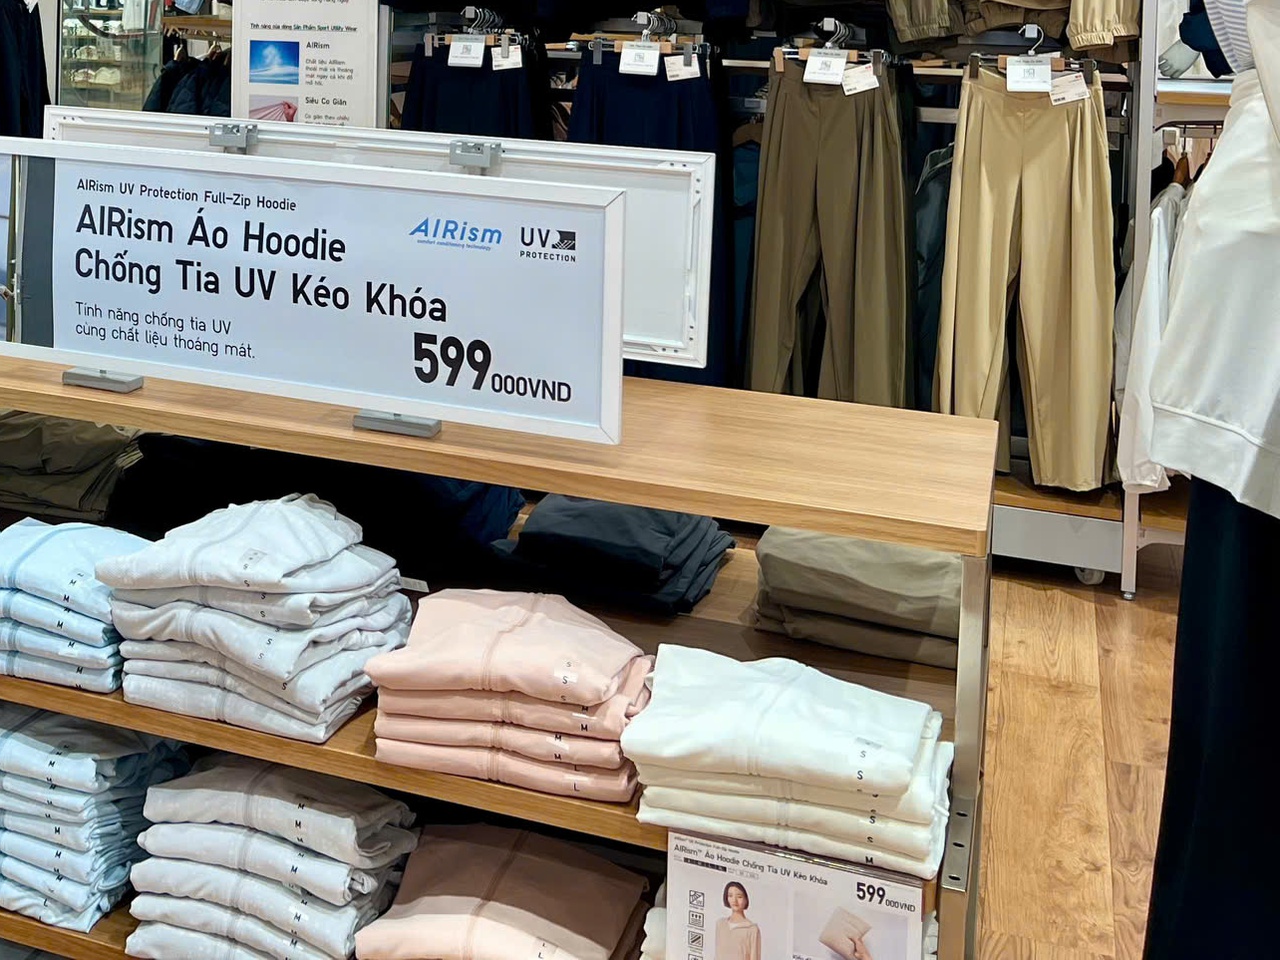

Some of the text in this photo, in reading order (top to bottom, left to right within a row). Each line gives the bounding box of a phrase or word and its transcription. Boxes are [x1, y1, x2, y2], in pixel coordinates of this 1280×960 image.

[77, 178, 114, 193] AIRism
[119, 181, 135, 195] UV
[140, 184, 198, 202] Protection
[256, 195, 296, 211] Hoodie
[75, 204, 346, 263] AIRism Áo Hoodie
[409, 217, 503, 245] AIRism
[521, 227, 550, 248] UV
[520, 250, 576, 263] PROTECTION
[75, 248, 447, 322] Chống Tia UV Kéo Khóa
[75, 301, 231, 335] Tính năng chống tia UV
[75, 322, 256, 359] cùng chất liệu thoáng mát.
[57, 620, 63, 629] M
[562, 676, 568, 684] S
[282, 682, 287, 690] S
[581, 723, 588, 732] M
[554, 753, 561, 761] M
[860, 750, 866, 758] S
[857, 770, 863, 780] S
[574, 783, 580, 792] L
[295, 820, 302, 828] M
[869, 816, 876, 824] S
[865, 856, 873, 864] M
[291, 865, 298, 874] M
[717, 854, 740, 865] Hoodie
[742, 860, 765, 872] Chống
[767, 865, 778, 875] Tia
[781, 867, 791, 877] UV
[294, 913, 301, 922] M
